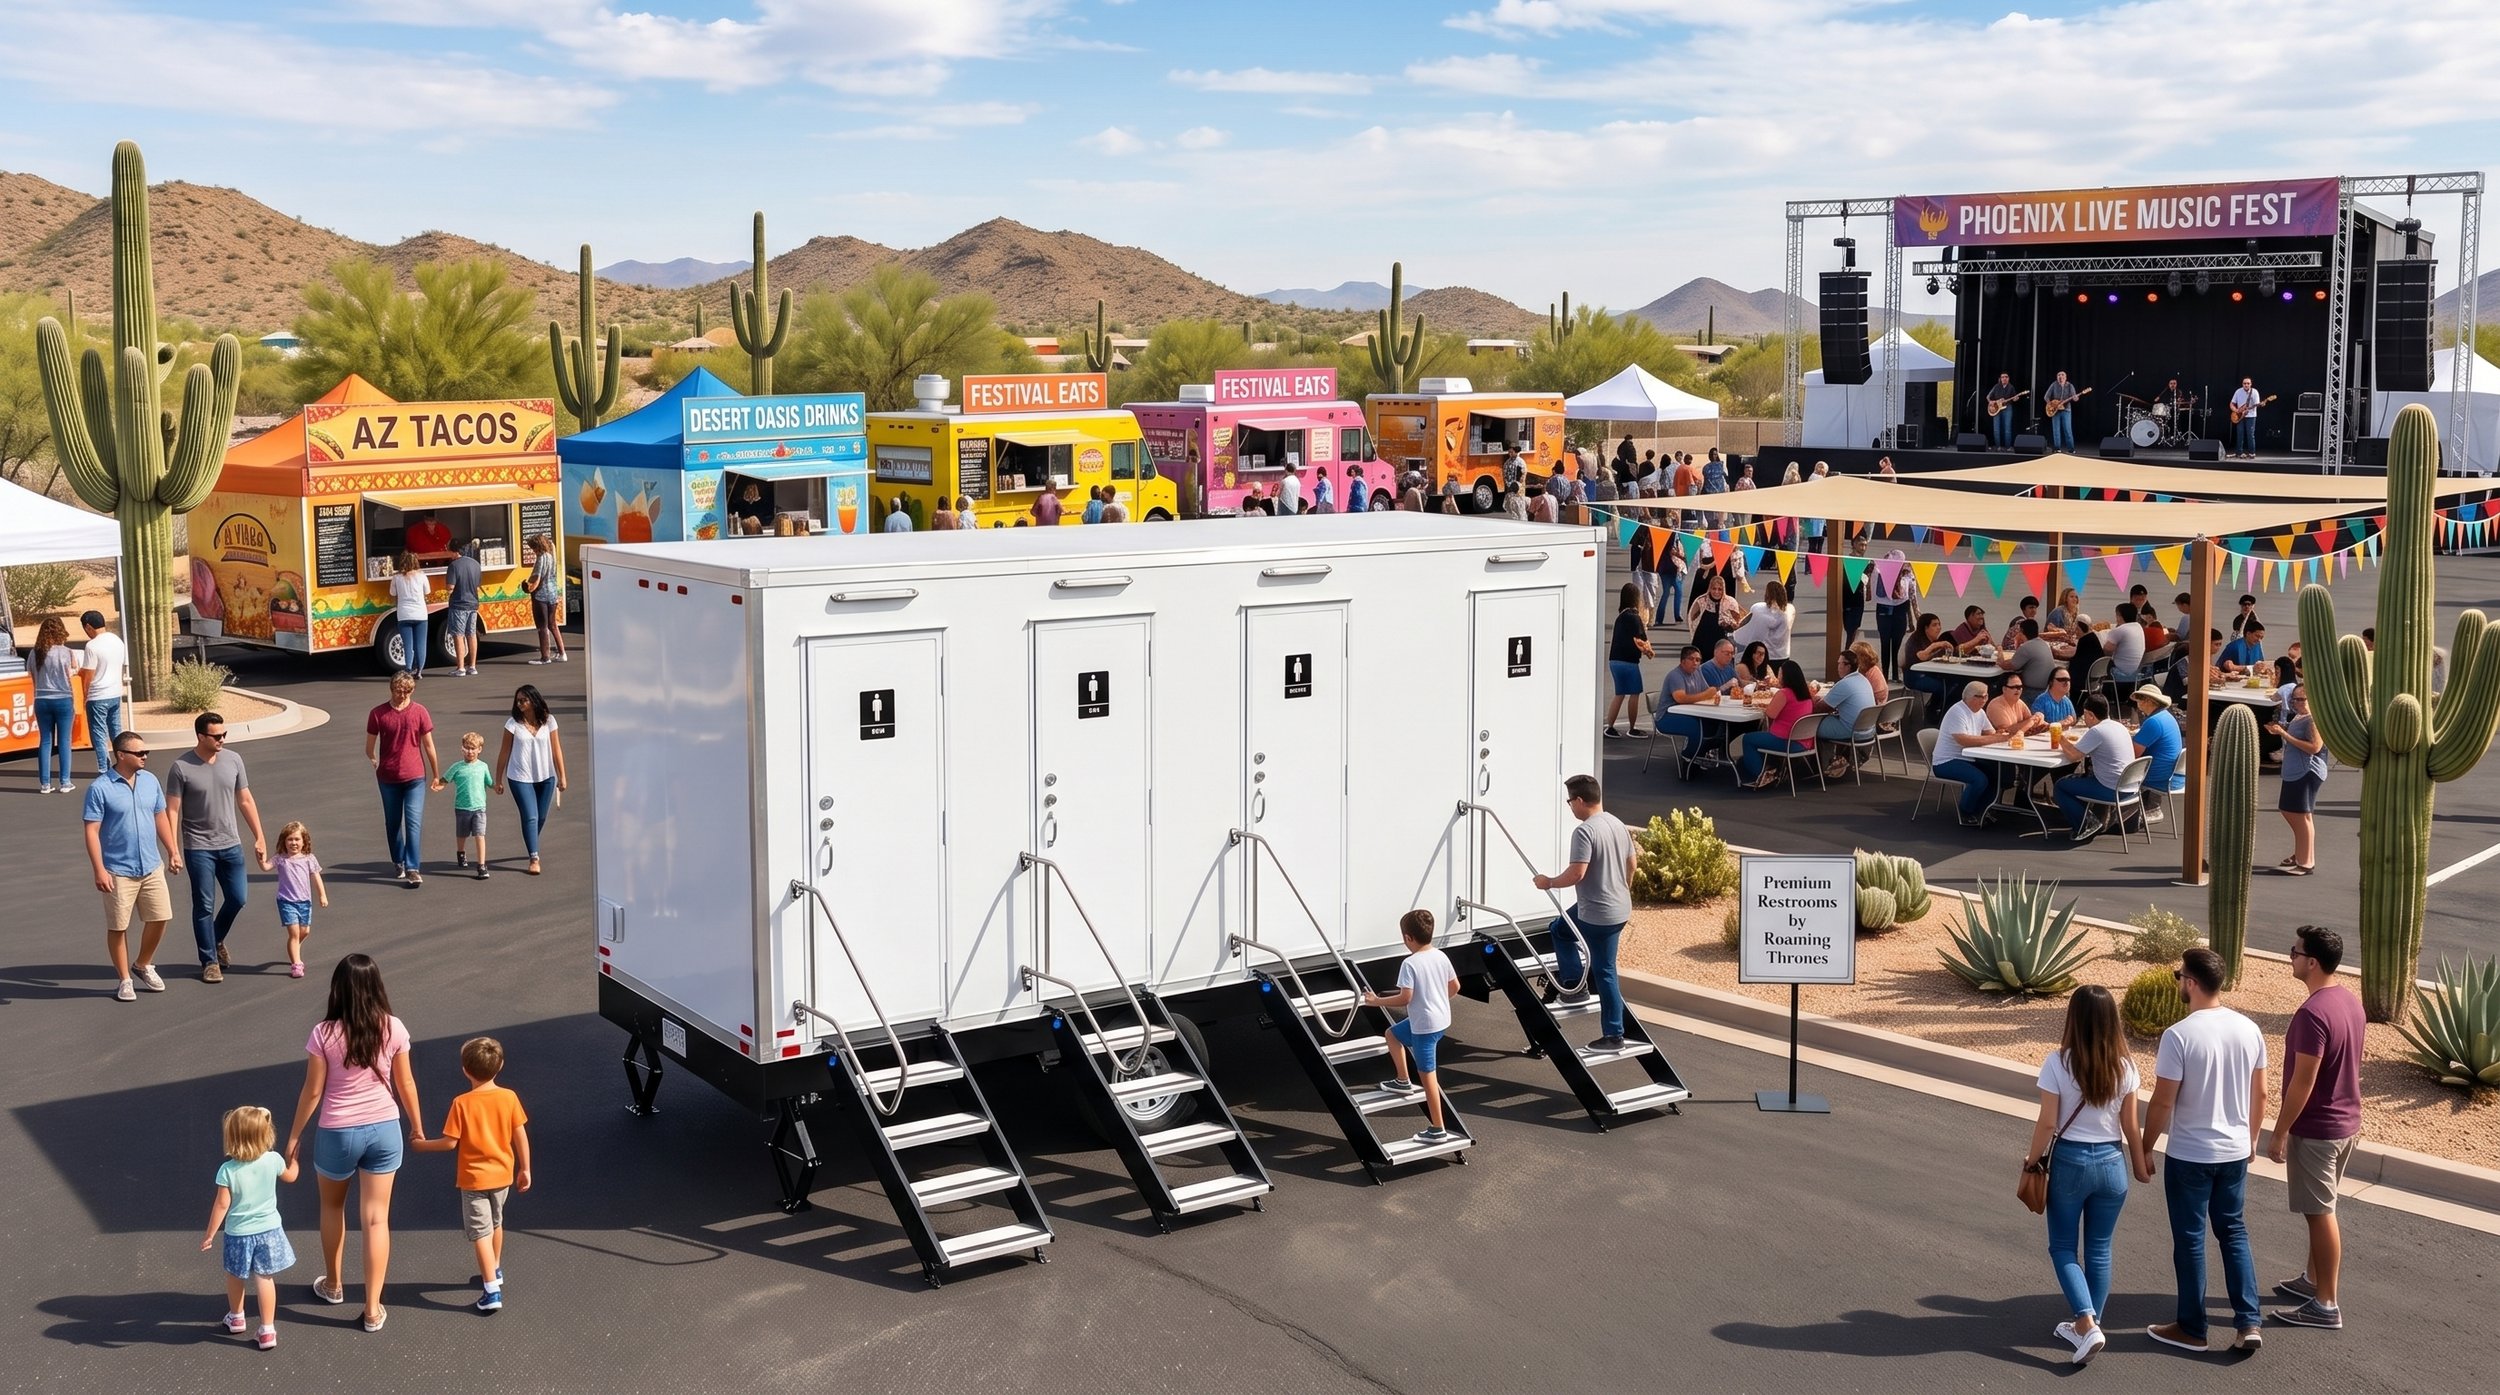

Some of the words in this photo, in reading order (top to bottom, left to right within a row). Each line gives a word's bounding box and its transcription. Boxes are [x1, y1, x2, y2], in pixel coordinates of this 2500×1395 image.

[1959, 201, 2066, 235] PHOENIX
[2074, 199, 2129, 232] LIVE
[2137, 196, 2221, 230] MUSIC
[2229, 192, 2297, 226] FEST
[971, 383, 1054, 406] FESTIVAL
[1059, 381, 1099, 404] EATS
[1222, 376, 1292, 399] FESTIVAL
[1295, 375, 1330, 396] EATS
[690, 407, 750, 432] DESERT
[755, 405, 800, 430] OASIS
[804, 402, 859, 427] DRINKS
[352, 416, 398, 449] AZ
[409, 412, 518, 447] TACOS
[1764, 876, 1831, 889] Premium
[1758, 894, 1837, 909] Restrooms
[1789, 914, 1806, 930] by
[1764, 932, 1831, 949] Roaming
[1766, 951, 1829, 965] Thrones
